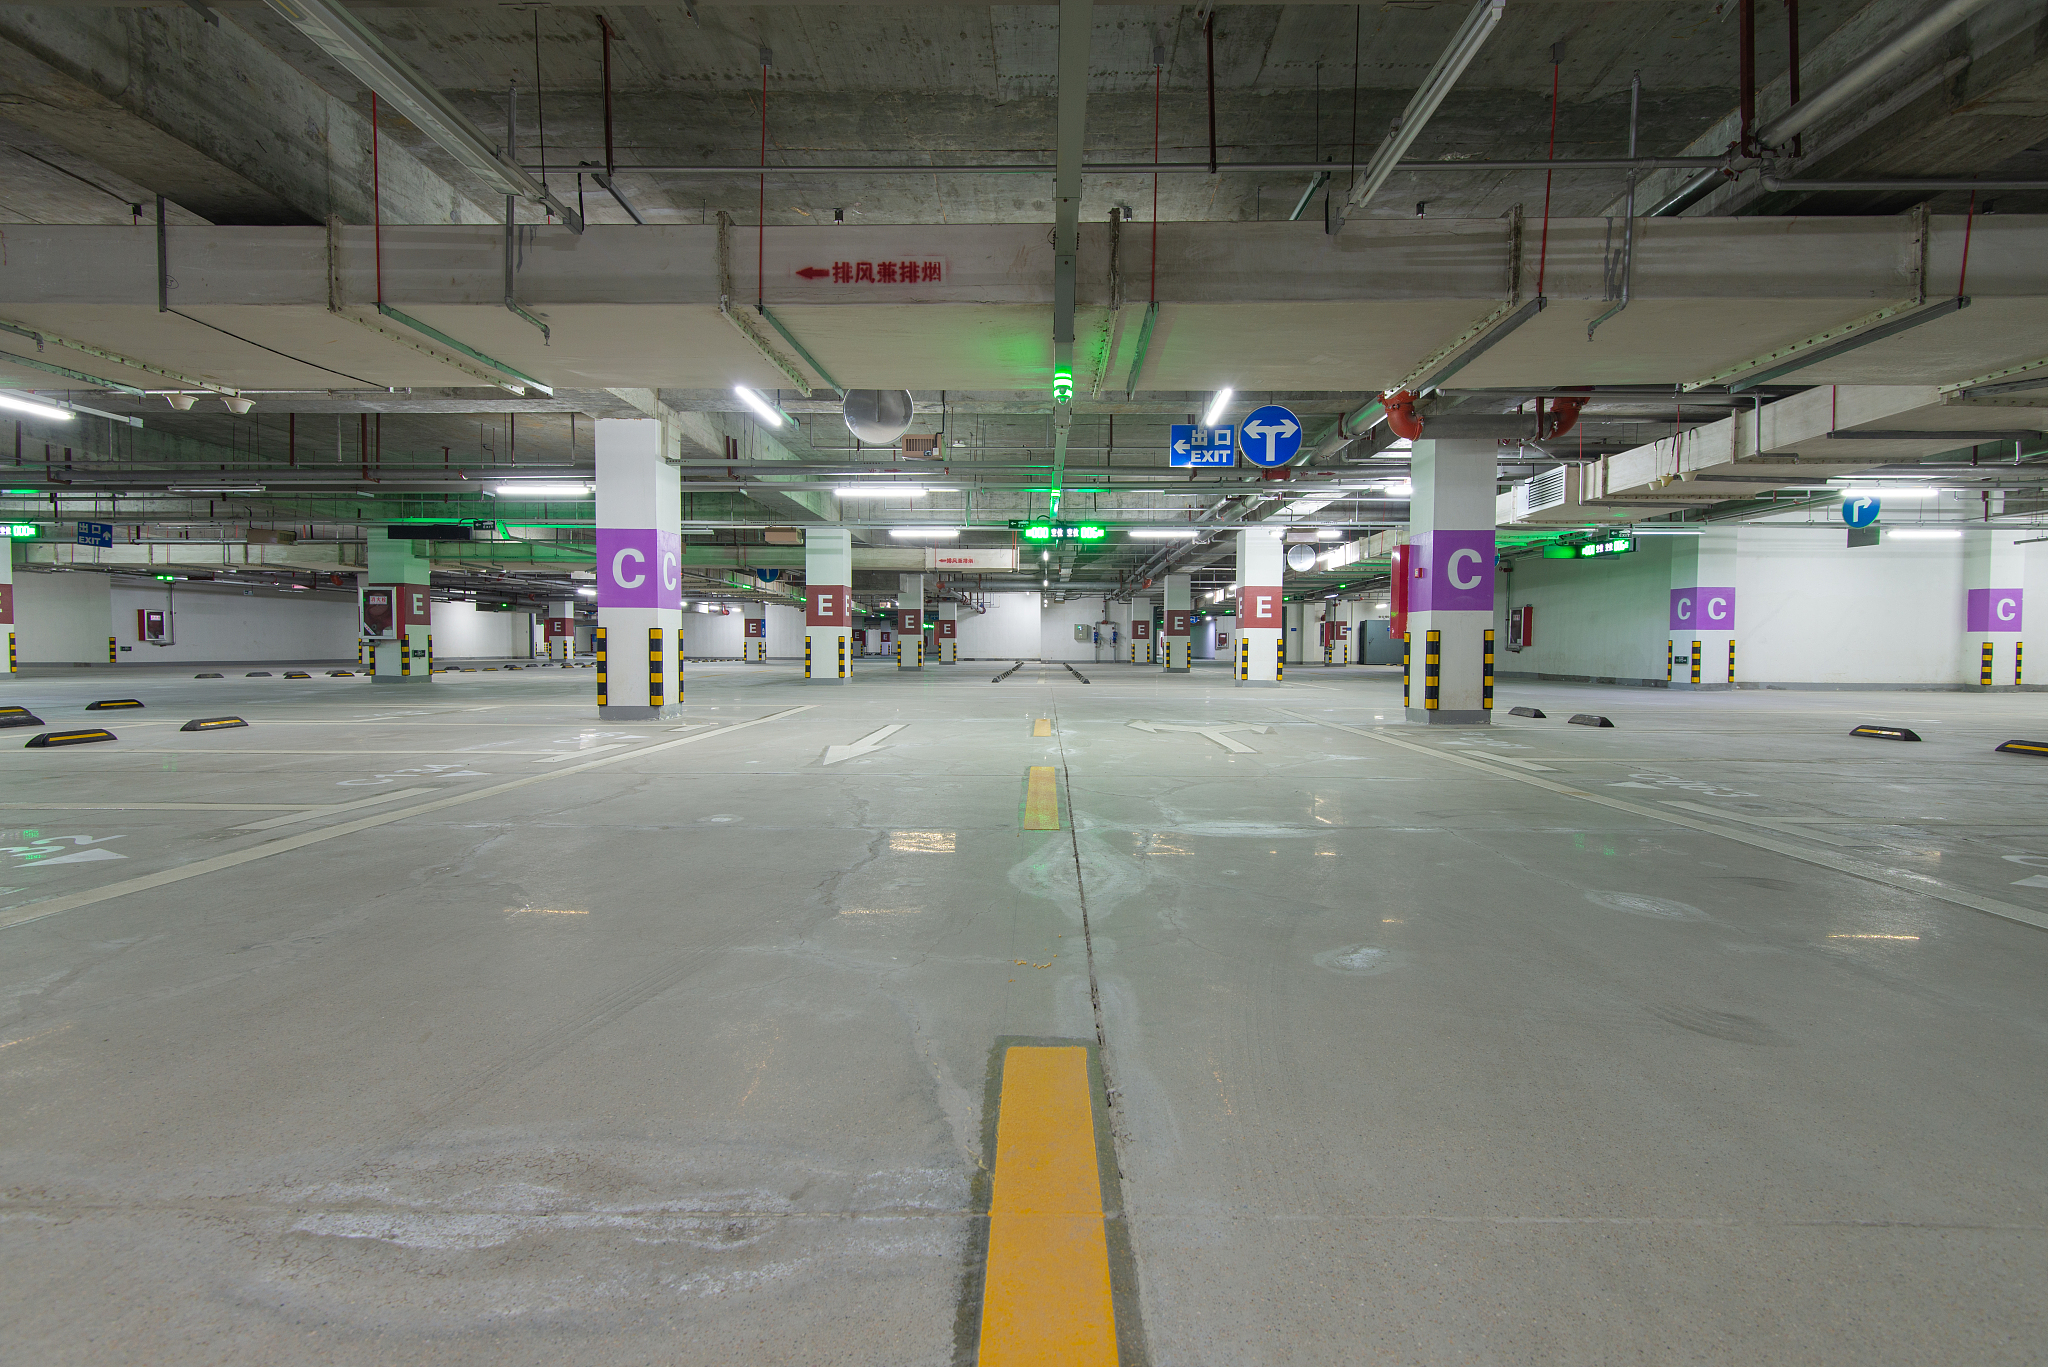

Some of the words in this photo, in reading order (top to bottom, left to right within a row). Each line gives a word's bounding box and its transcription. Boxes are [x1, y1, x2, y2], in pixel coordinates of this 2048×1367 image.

[832, 261, 941, 284] 排风兼排烟
[1191, 429, 1231, 446] 出口
[1190, 450, 1231, 463] EXIT
[78, 522, 101, 534] 出口
[78, 535, 101, 545] EXIT
[612, 547, 646, 589] C
[663, 551, 677, 591] C
[1447, 548, 1482, 590] C
[412, 593, 424, 615] E
[818, 594, 834, 616] E
[845, 594, 850, 617] E
[1238, 596, 1243, 619] E
[1256, 595, 1272, 618] E
[1677, 597, 1691, 620] C
[1707, 597, 1727, 620] C
[1996, 598, 2016, 621] C
[554, 621, 562, 632] E
[749, 623, 757, 633] E
[904, 615, 915, 629] E
[943, 623, 951, 634] E
[1137, 625, 1145, 635] E
[1174, 616, 1184, 630] E
[1340, 625, 1347, 636] E
[854, 631, 860, 639] E
